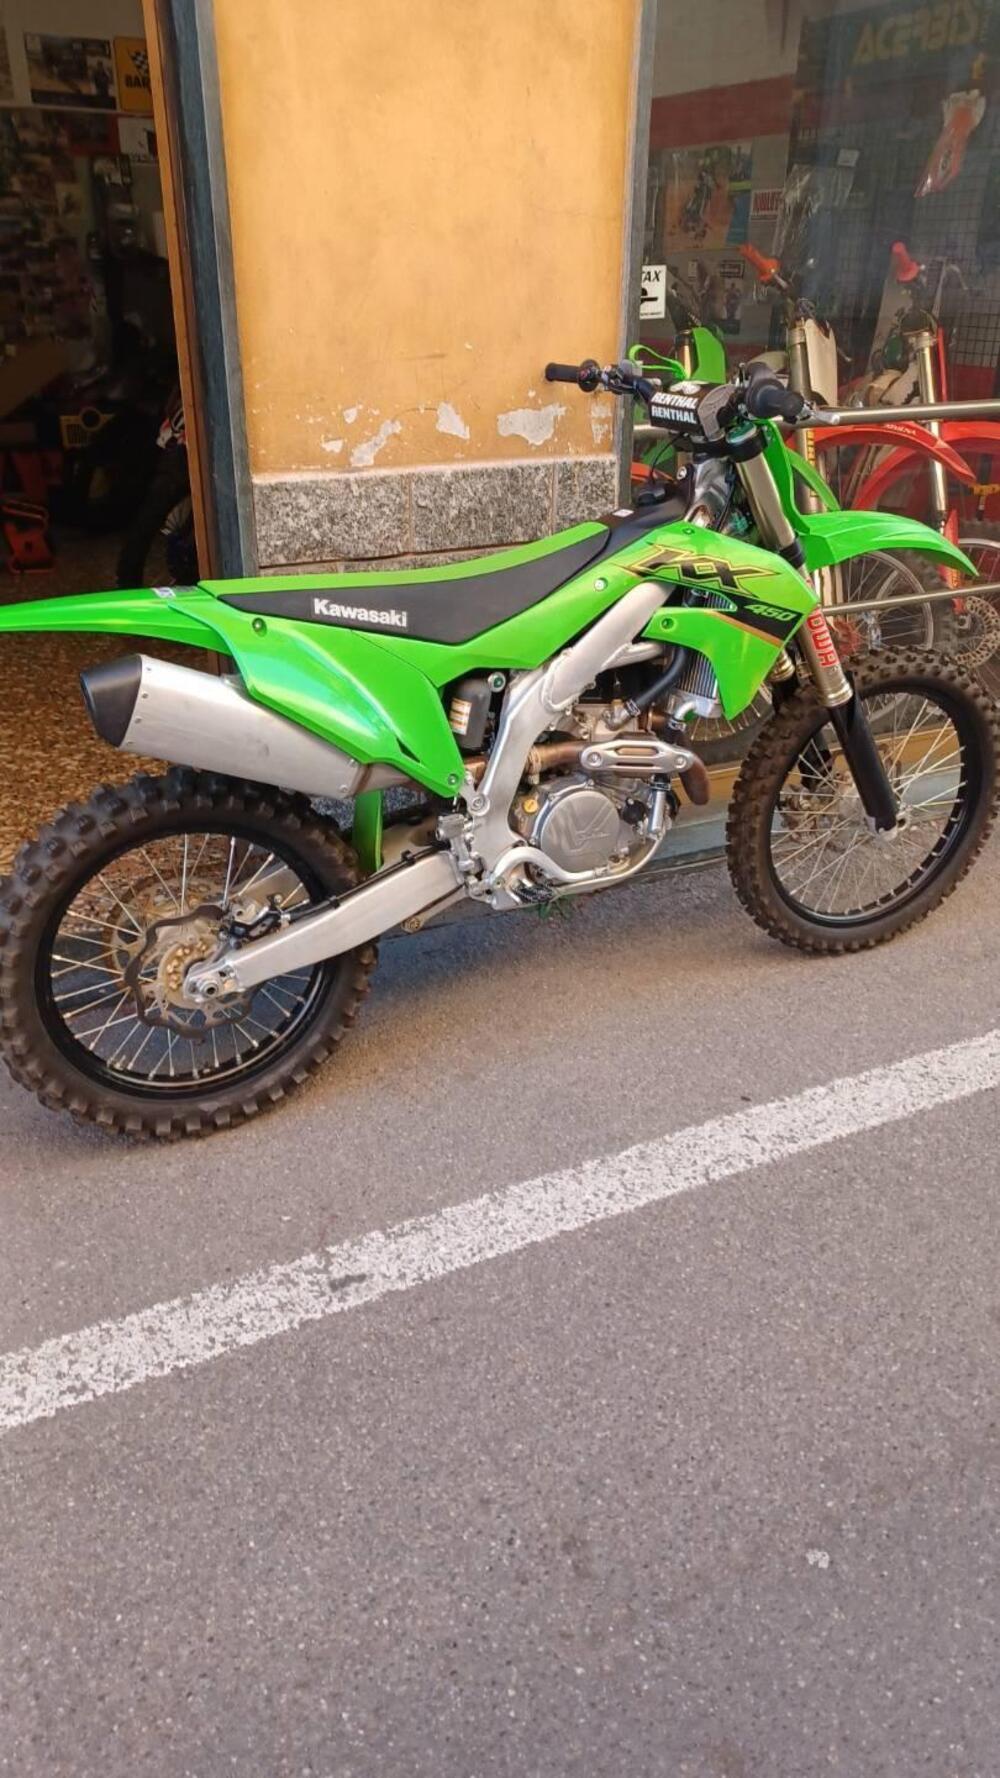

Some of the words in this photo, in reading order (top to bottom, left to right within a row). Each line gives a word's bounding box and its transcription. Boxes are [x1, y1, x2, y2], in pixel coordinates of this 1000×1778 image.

[651, 392, 699, 409] RENTHAL
[652, 405, 697, 424] RENTHAL
[625, 545, 783, 598] KX
[314, 598, 407, 627] Kawasaki
[744, 604, 798, 621] 450
